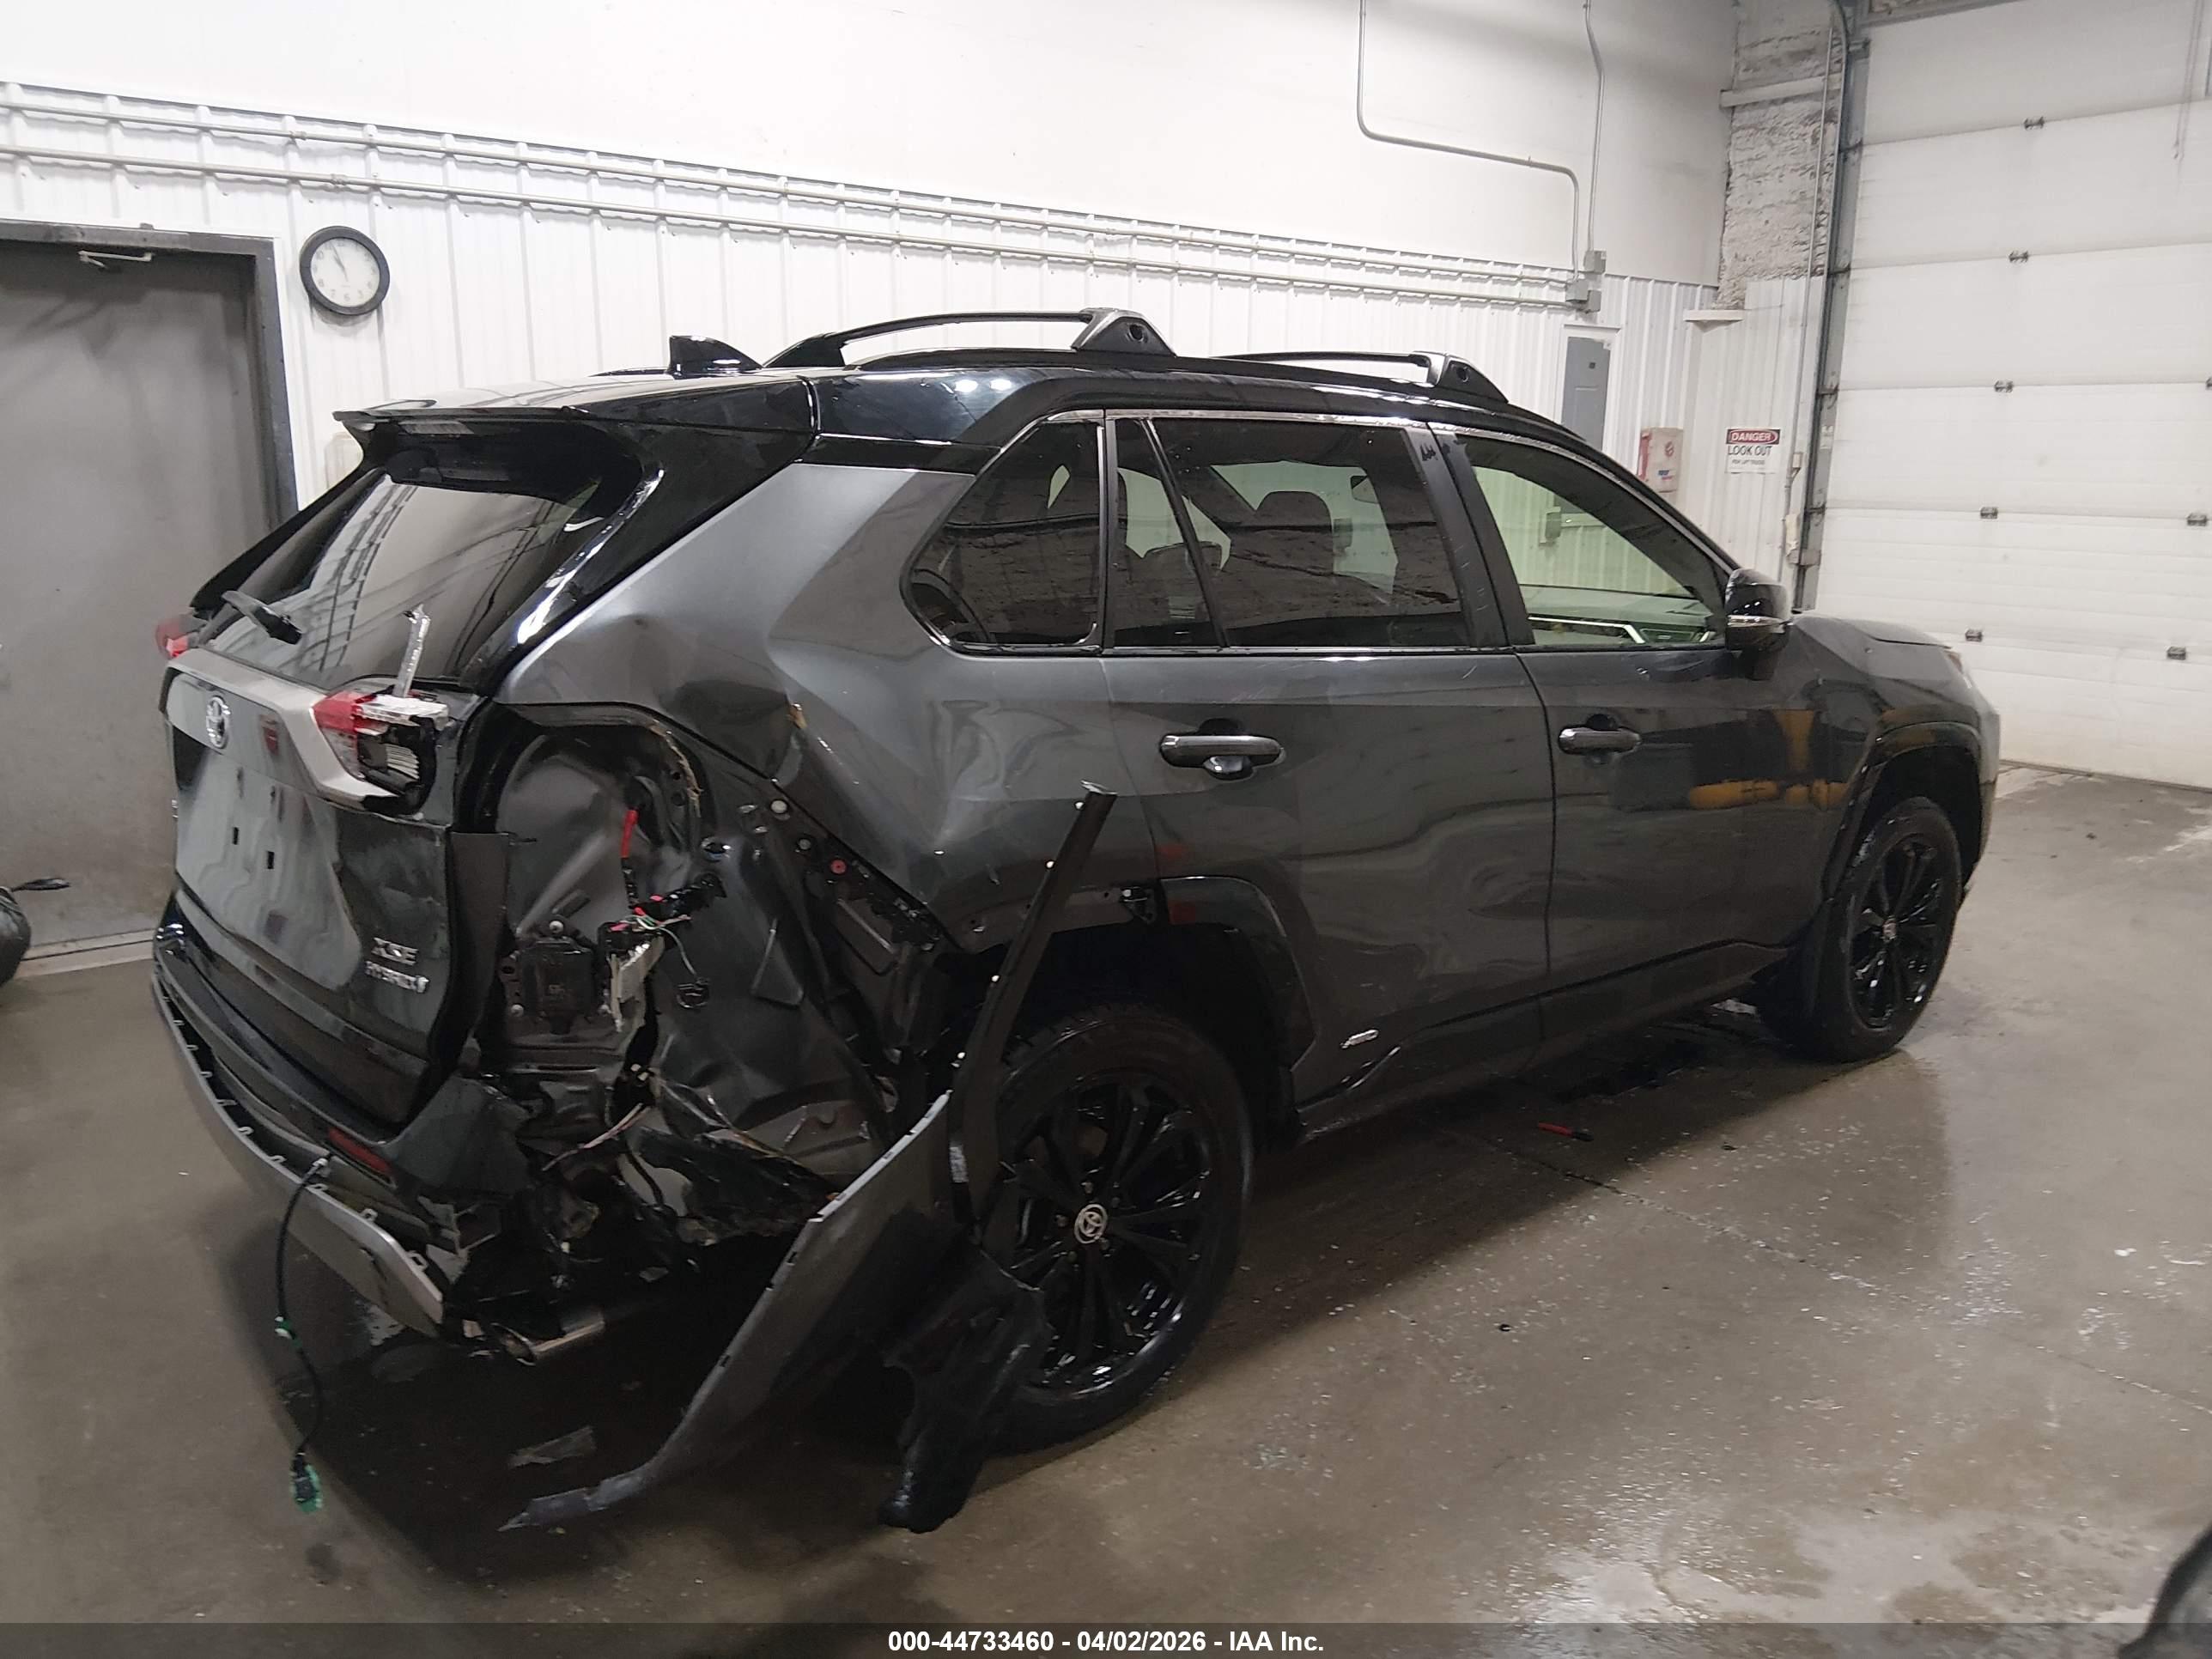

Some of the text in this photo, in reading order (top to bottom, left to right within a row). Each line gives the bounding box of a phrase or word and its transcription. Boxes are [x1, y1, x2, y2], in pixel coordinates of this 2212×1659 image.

[1731, 432, 1771, 441] DANGER
[1728, 445, 1772, 457] LOOK OUT
